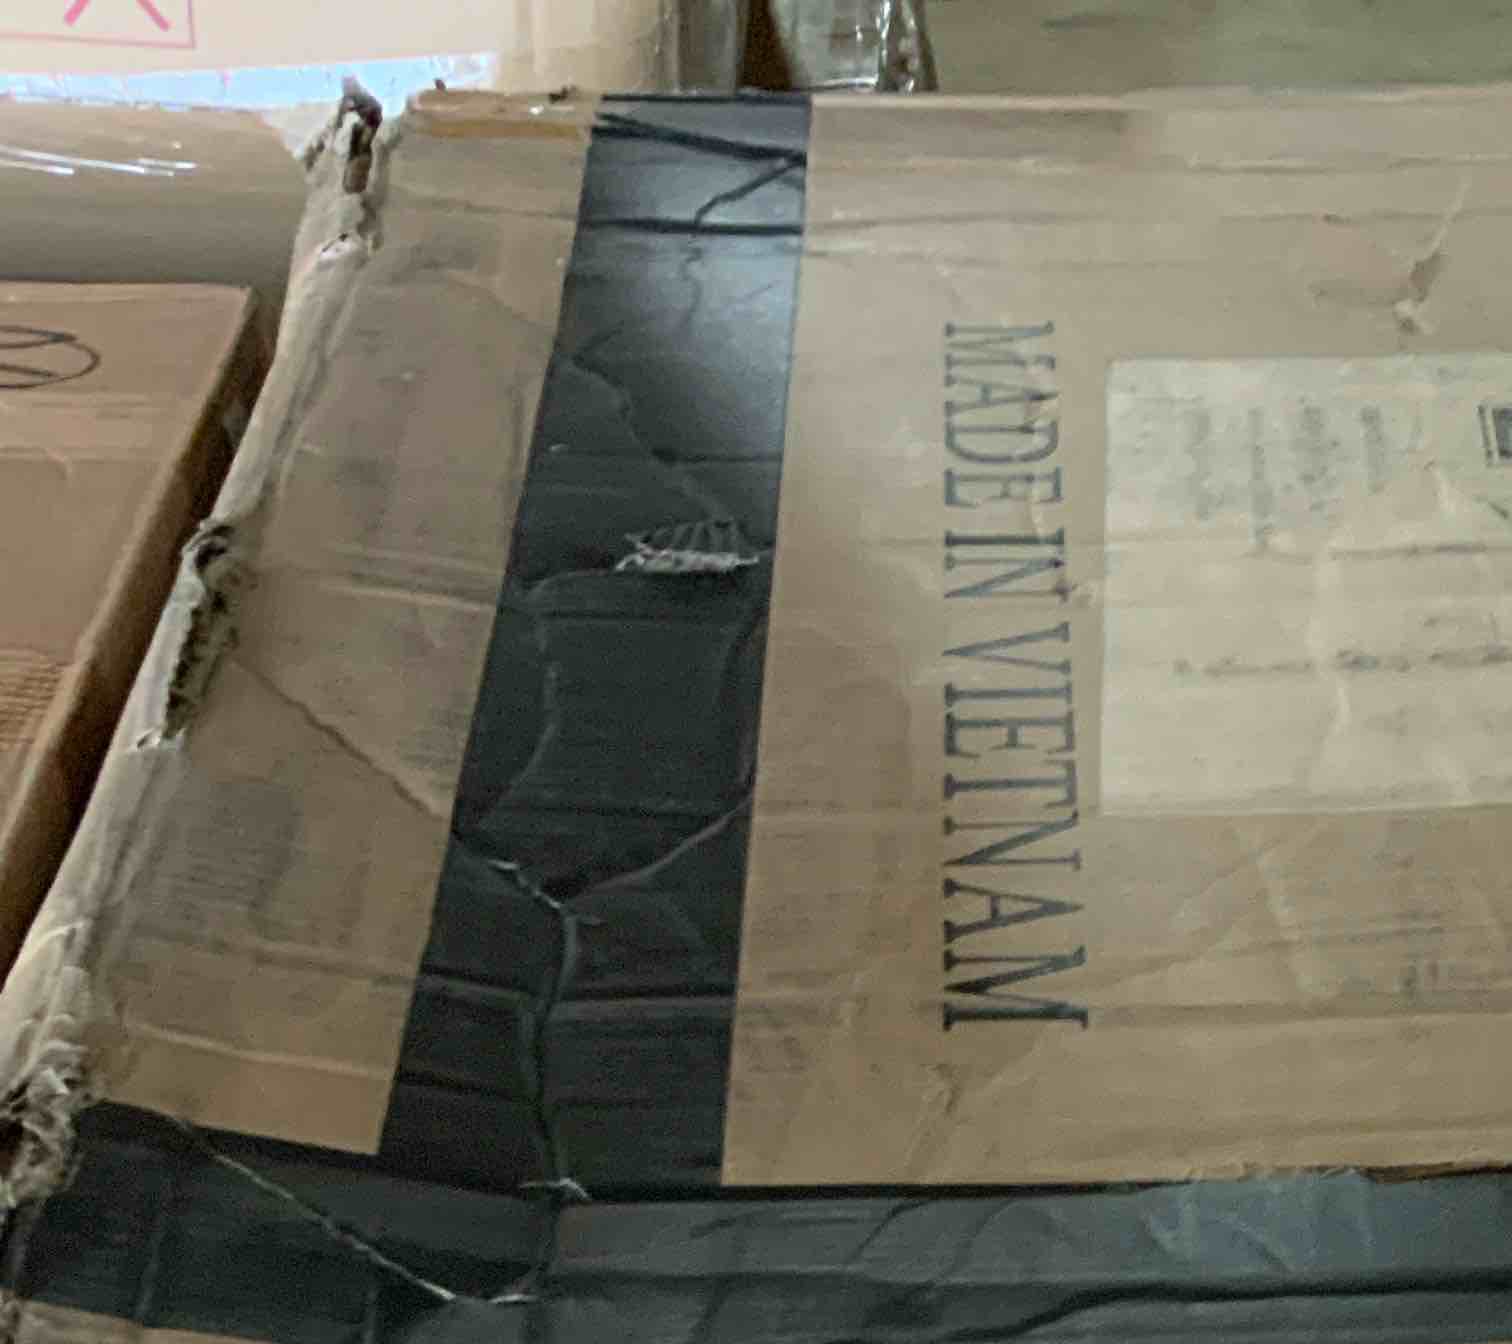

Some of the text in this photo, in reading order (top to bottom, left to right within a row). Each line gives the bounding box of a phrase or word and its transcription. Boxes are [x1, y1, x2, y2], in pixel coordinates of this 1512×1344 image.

[942, 320, 1088, 1031] MADE IN VIETNAM
